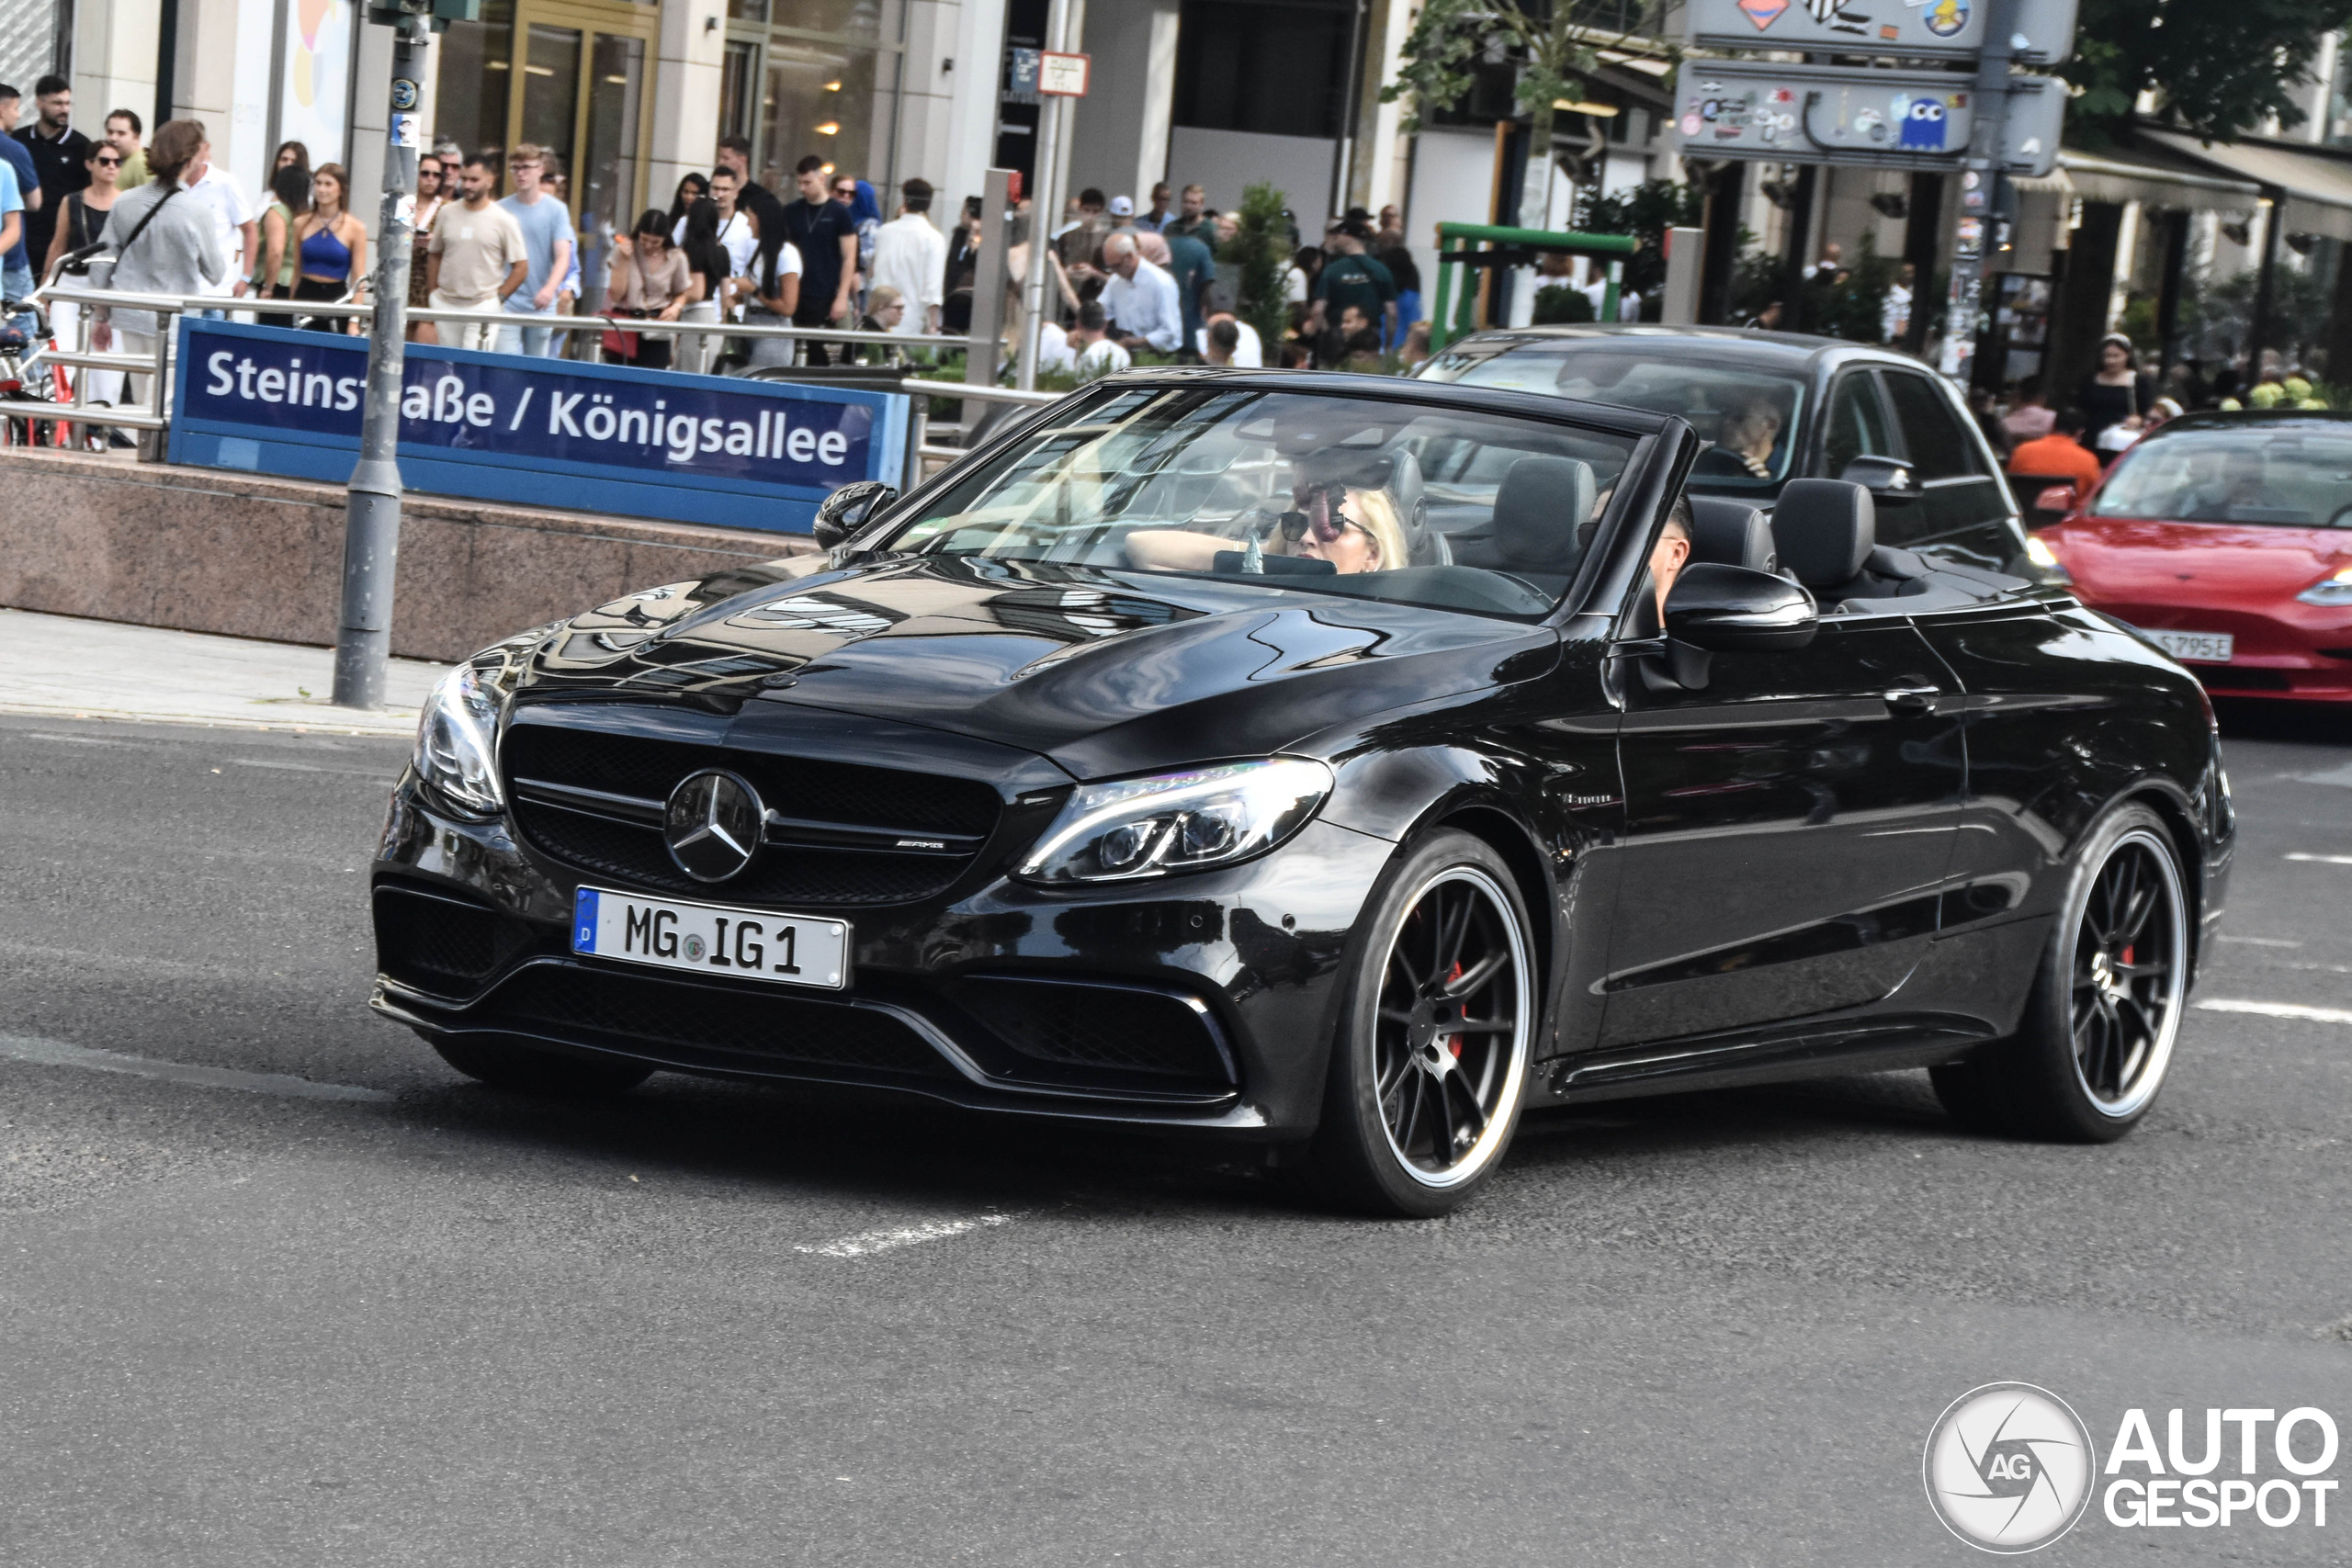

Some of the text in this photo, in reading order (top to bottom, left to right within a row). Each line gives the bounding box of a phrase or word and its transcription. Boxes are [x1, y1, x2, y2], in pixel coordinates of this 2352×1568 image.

[206, 351, 847, 466] Steinsaße / Königsallee
[581, 928, 591, 942] D
[626, 904, 678, 958] MG
